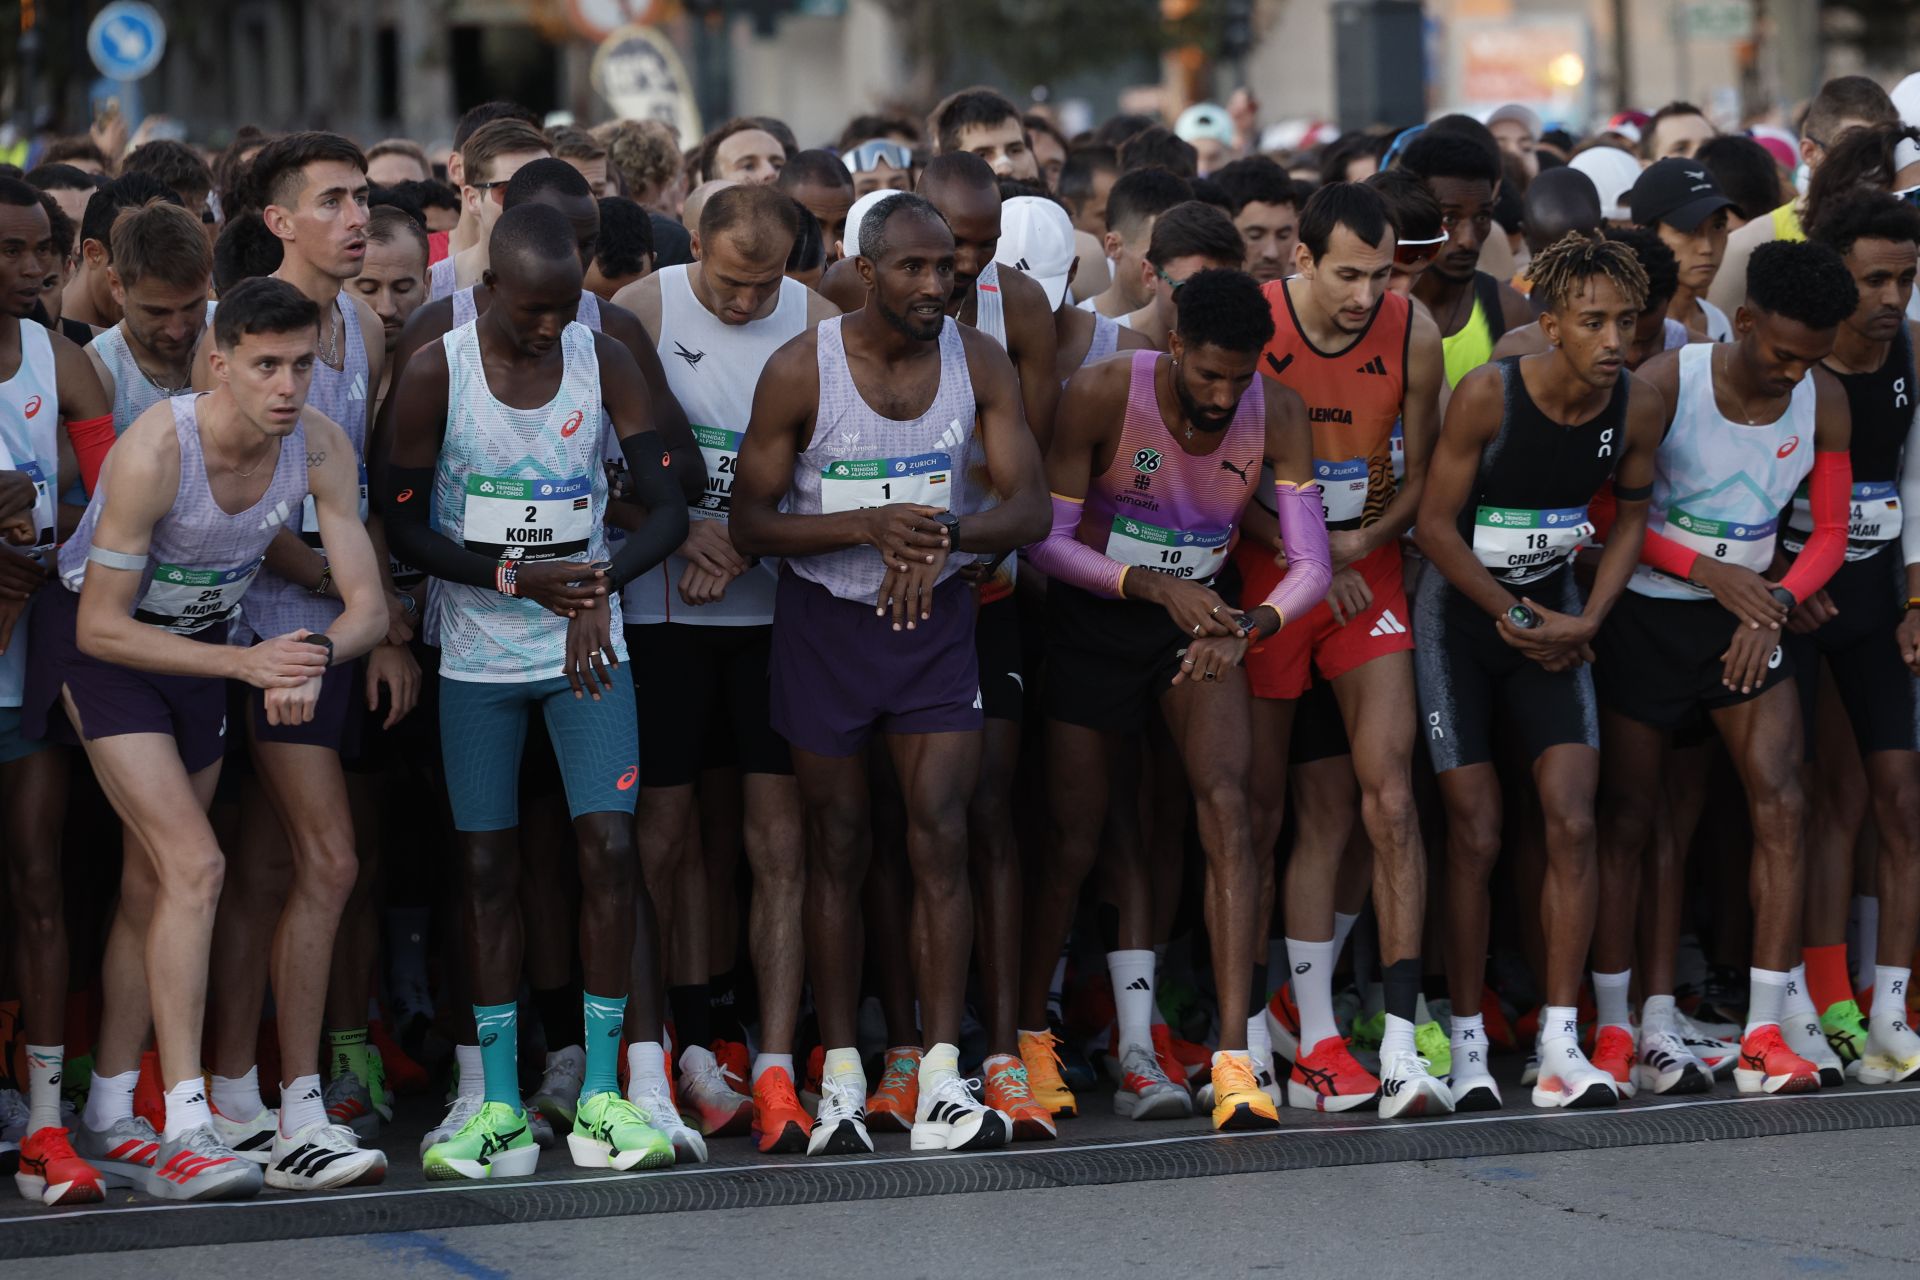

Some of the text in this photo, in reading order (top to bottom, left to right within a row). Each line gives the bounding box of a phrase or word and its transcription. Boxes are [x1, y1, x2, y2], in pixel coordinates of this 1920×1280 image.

[698, 438, 725, 447] ALFONSO
[699, 432, 726, 441] TRINIDAD
[909, 459, 937, 469] ZURICH
[1332, 466, 1359, 475] ZURICH
[555, 483, 581, 493] ZURICH
[881, 482, 891, 500] 1
[1115, 494, 1160, 512] amazfit
[524, 505, 537, 523] 2
[1849, 504, 1863, 520] 4
[506, 527, 553, 543] KORIR
[1526, 533, 1548, 550] 18
[1160, 550, 1182, 564] 10
[1714, 543, 1727, 557] 8
[1507, 549, 1556, 566] CRIPPA
[198, 588, 222, 602] 25
[182, 602, 222, 615] MAYO
